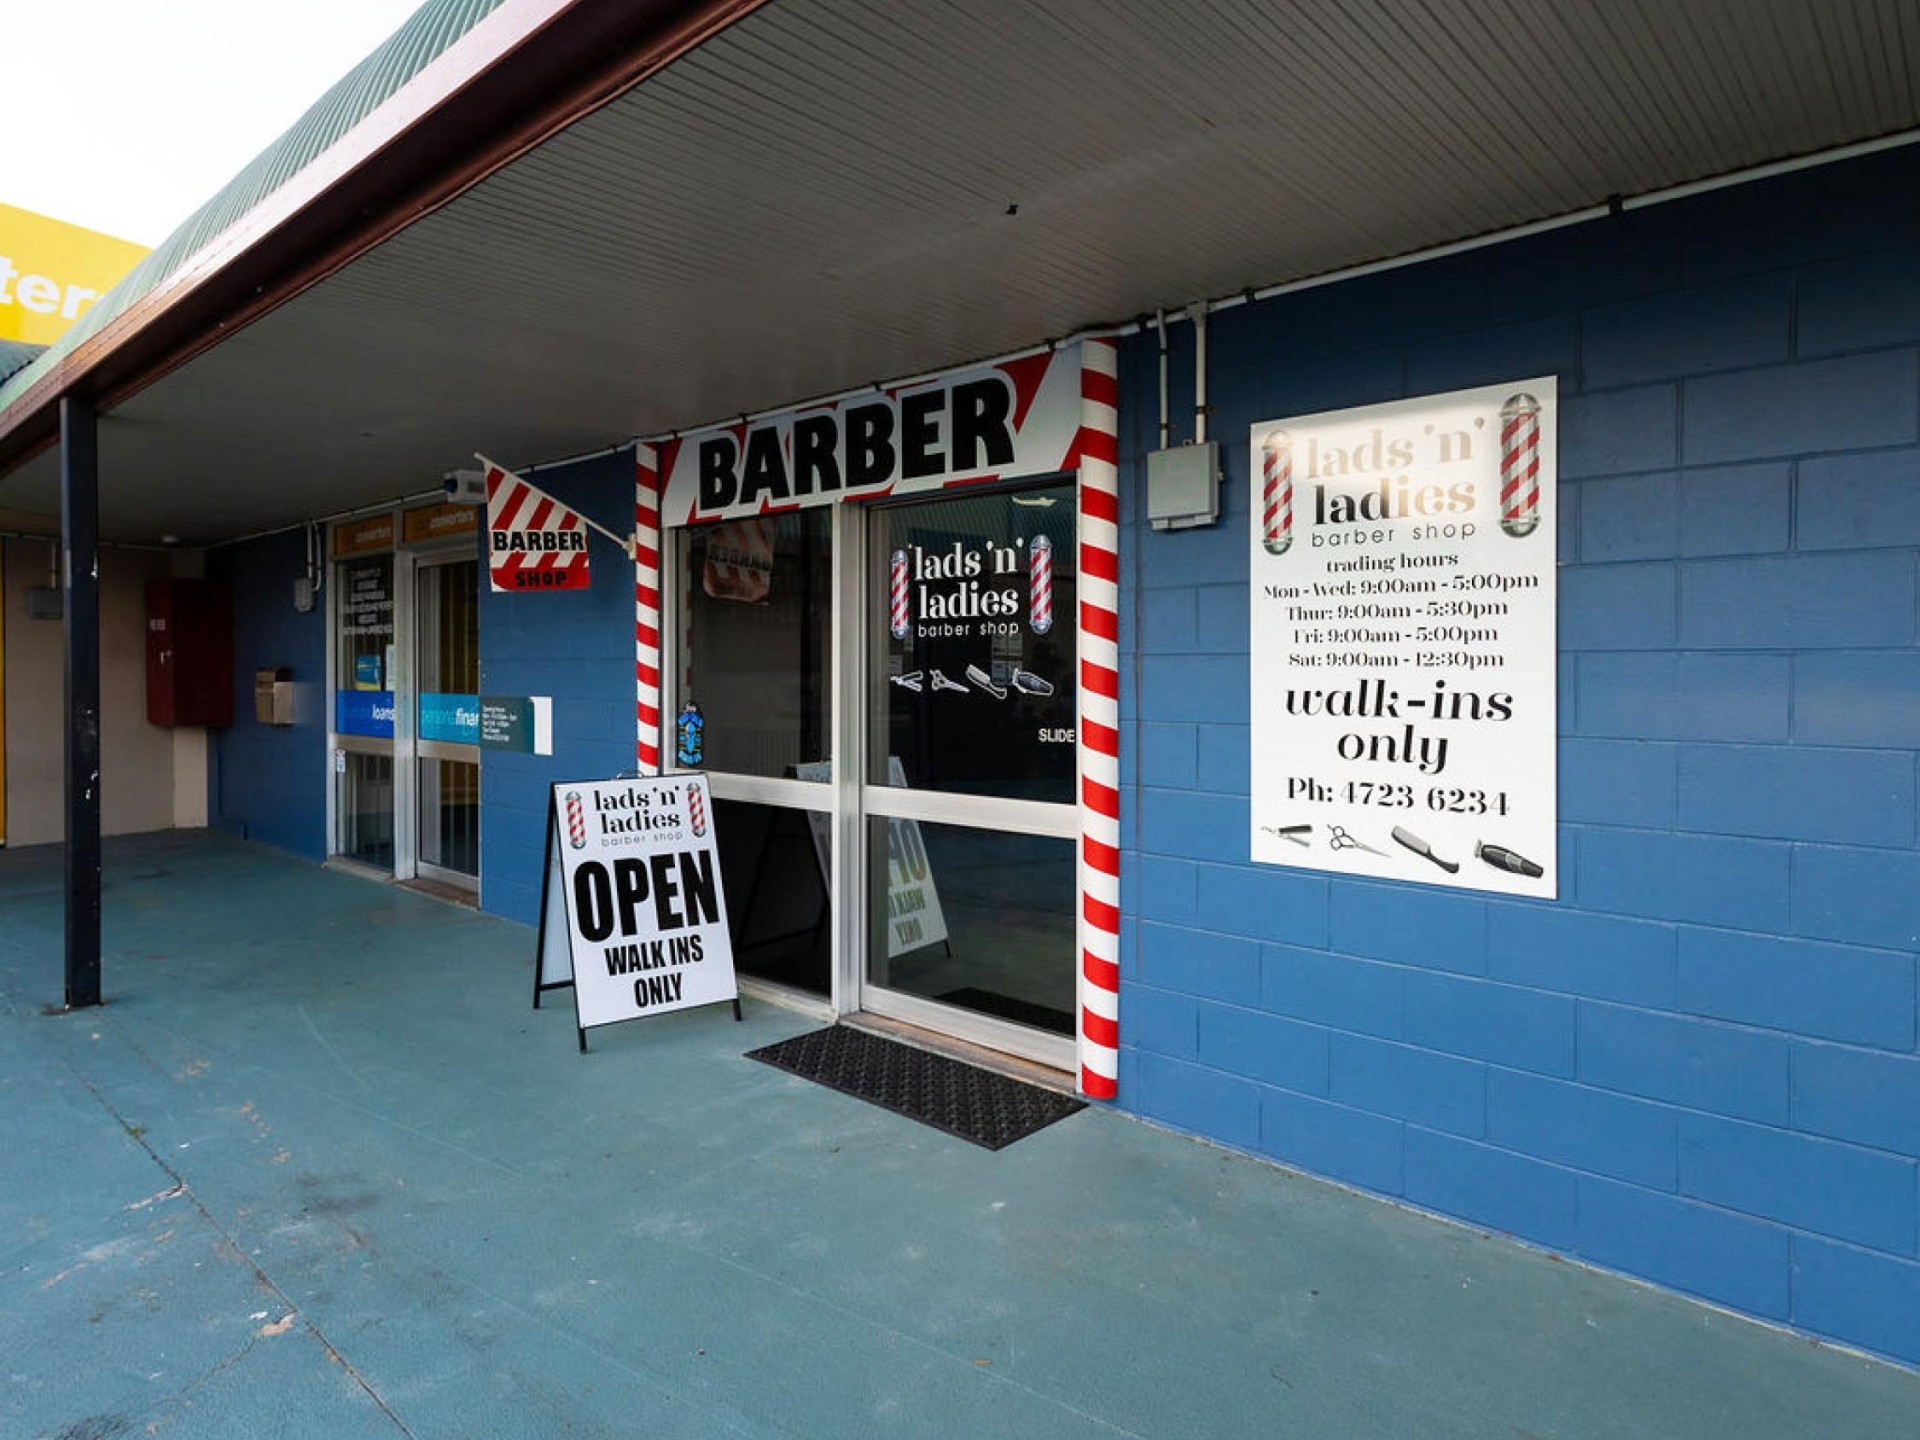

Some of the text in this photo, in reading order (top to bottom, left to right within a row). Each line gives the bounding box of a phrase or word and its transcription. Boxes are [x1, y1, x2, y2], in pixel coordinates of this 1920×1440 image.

[0, 256, 107, 320] ter
[700, 377, 1015, 511] BARBER
[1306, 428, 1413, 479] lads
[1312, 475, 1476, 525] ladies
[493, 531, 584, 551] BARBER
[1312, 522, 1476, 548] barber shop
[915, 542, 981, 580] lads
[1326, 553, 1459, 573] trading hours
[515, 570, 568, 588] SHOP
[1264, 585, 1300, 598] Mon
[1313, 580, 1356, 596] Wed:
[1360, 579, 1436, 595] 9:00am
[1452, 574, 1539, 592] 5:00pm
[919, 581, 1019, 619] ladies
[1286, 605, 1333, 621] Thur:
[1338, 604, 1410, 619] 9:00am
[1426, 601, 1508, 619] 5:30pm
[918, 621, 1019, 638] barber shop
[1294, 628, 1323, 643] Fri:
[1327, 628, 1399, 643] 9:00am
[1416, 626, 1498, 645] 5:00pm
[1289, 653, 1322, 667] Sat:
[1326, 652, 1398, 667] 9:00am
[1416, 651, 1504, 670] 12:30pm
[1286, 678, 1513, 721] walk-ins
[1038, 728, 1075, 744] SLIDE
[1337, 724, 1448, 775] only
[594, 787, 650, 811] lads
[1288, 777, 1511, 816] Ph: 4723 6234
[601, 808, 681, 834] ladies
[602, 832, 683, 847] barber shop
[574, 850, 720, 942] OPEN
[605, 934, 704, 976] WALK INS
[634, 972, 682, 1008] ONLY
